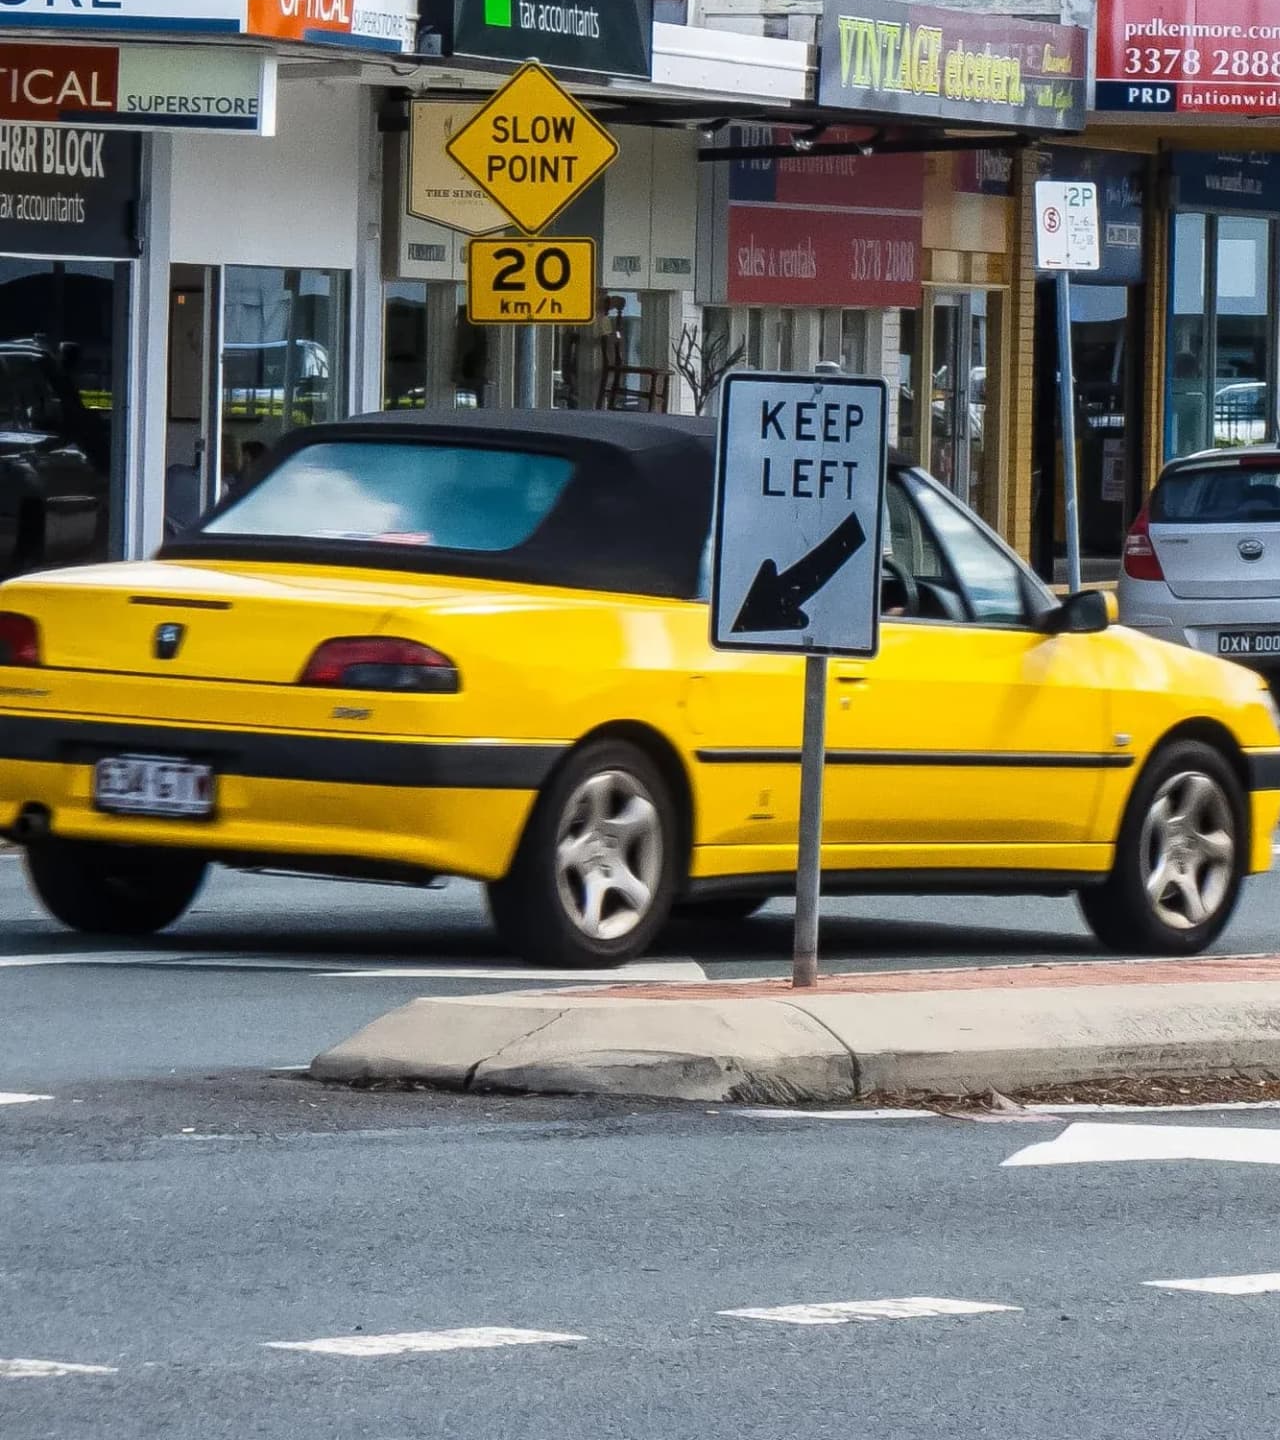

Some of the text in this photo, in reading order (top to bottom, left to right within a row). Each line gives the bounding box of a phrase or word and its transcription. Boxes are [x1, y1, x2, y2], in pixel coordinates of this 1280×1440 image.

[538, 3, 600, 39] accountants
[838, 14, 943, 97] VINTAGE
[1124, 47, 1201, 76] 3378
[127, 94, 260, 116] SUPERSTORE
[1128, 88, 1172, 104] PRD
[491, 115, 576, 144] SLOW
[43, 127, 105, 179] BLOCK
[487, 155, 579, 184] POINT
[0, 192, 86, 224] ax accountants
[425, 189, 489, 199] THE SINGL
[1068, 186, 1094, 207] 2P
[491, 247, 572, 292] 20
[500, 297, 563, 315] km/h
[760, 399, 865, 444] KEEP
[762, 457, 859, 501] LEFT
